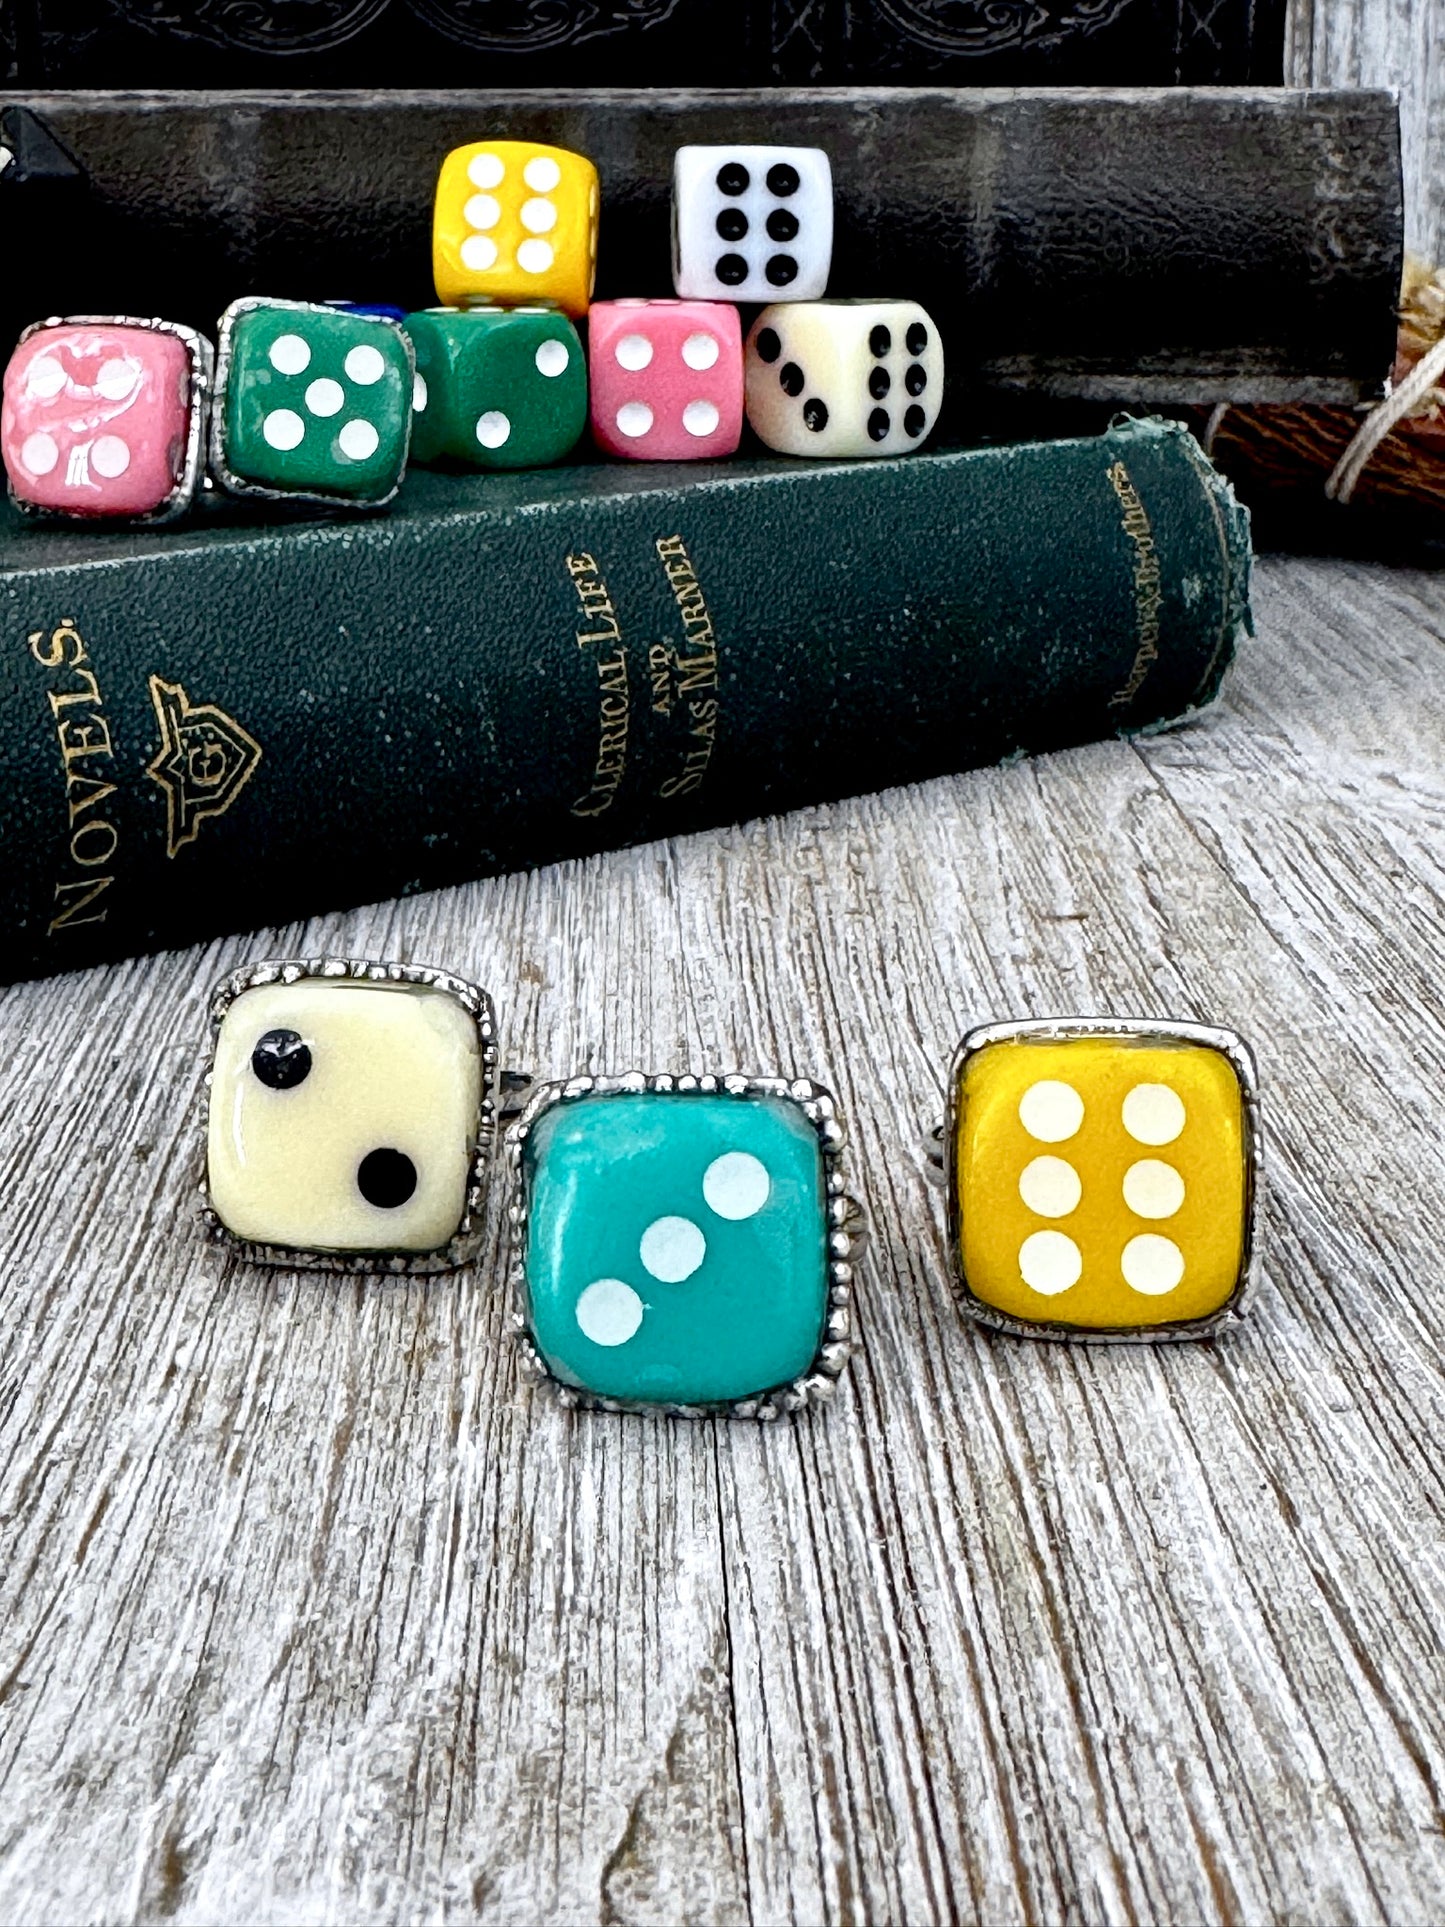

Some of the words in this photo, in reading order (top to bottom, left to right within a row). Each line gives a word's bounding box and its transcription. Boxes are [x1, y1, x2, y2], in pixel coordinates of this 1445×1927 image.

[565, 552, 622, 650] LIFE
[655, 534, 719, 699] MARNER
[649, 643, 675, 718] AND
[570, 647, 629, 817] CLERICAL
[660, 699, 719, 798] SILAS
